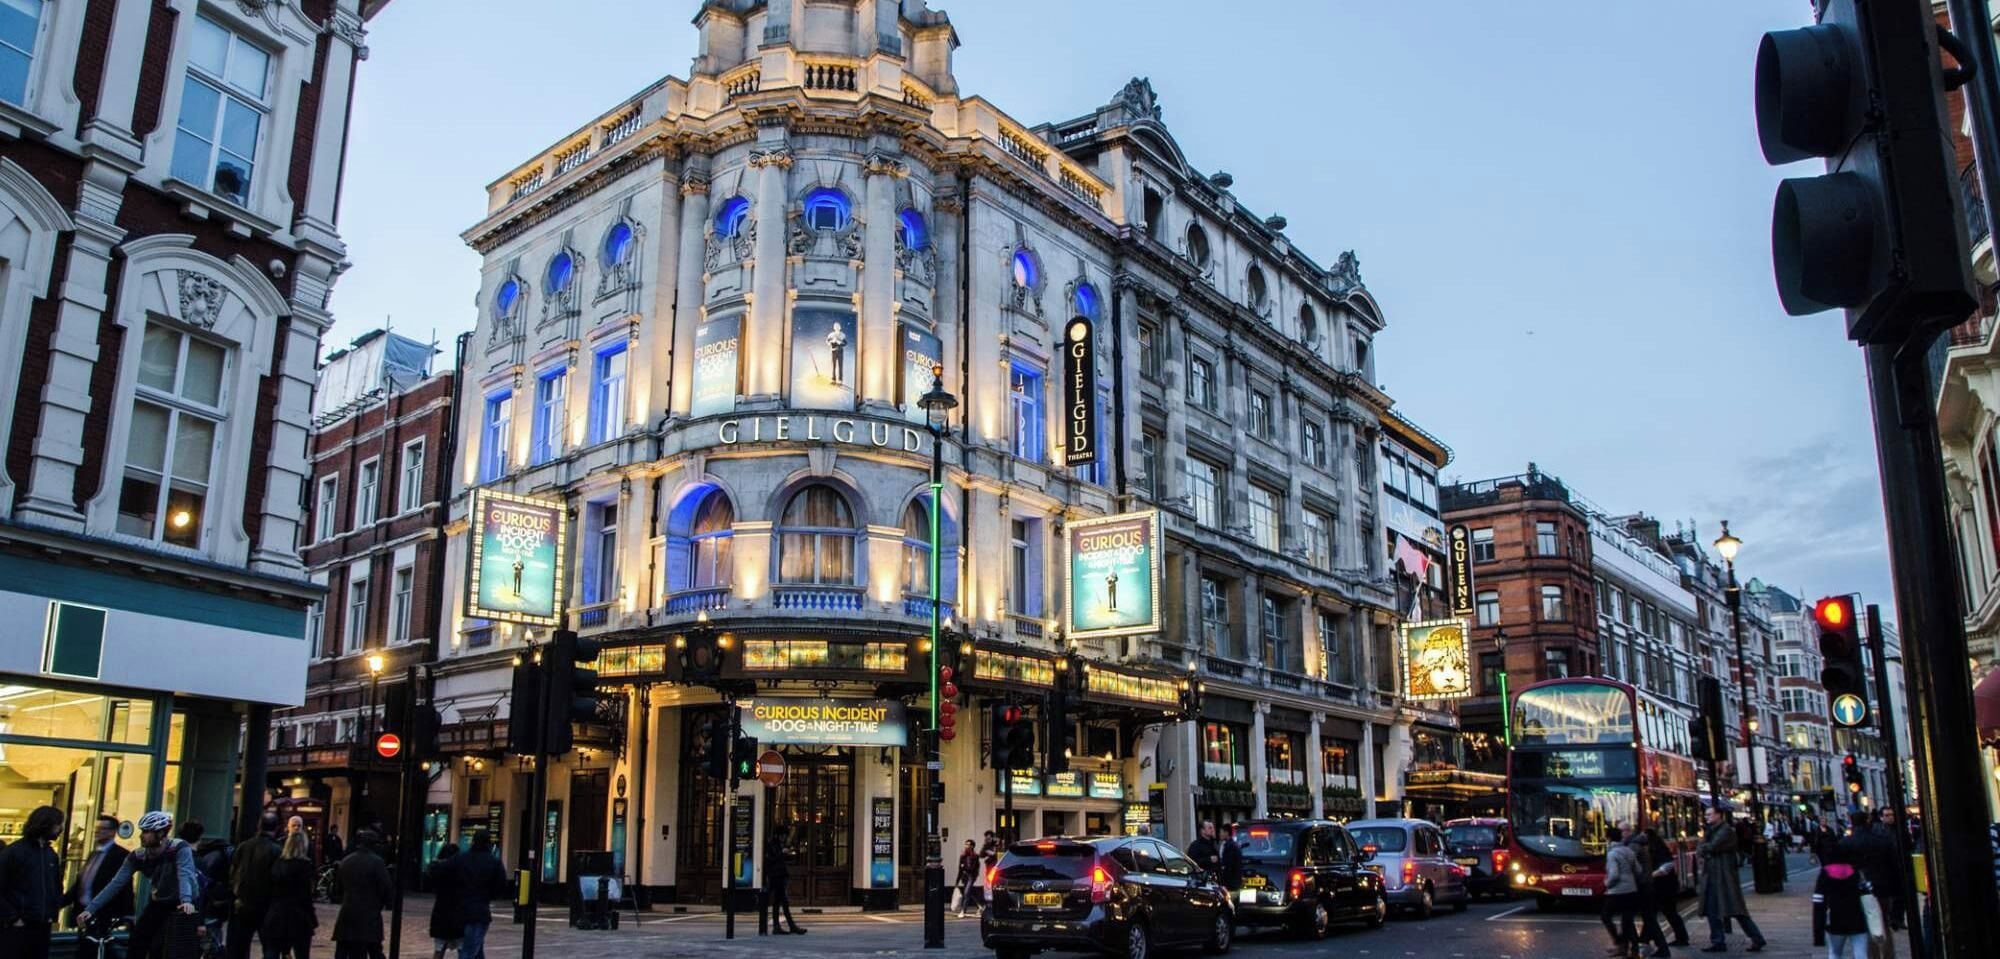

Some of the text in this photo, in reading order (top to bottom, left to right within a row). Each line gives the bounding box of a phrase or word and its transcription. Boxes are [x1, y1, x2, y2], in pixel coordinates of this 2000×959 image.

[695, 338, 737, 359] CURIOUS
[1072, 342, 1087, 452] GIELGUD
[719, 416, 921, 452] GIELGUD
[1067, 451, 1093, 462] THEATRE
[491, 510, 551, 531] CURIOUS
[500, 525, 545, 541] INCIDENT
[502, 534, 535, 550] DOG
[1080, 531, 1142, 552] CURIOUS
[1119, 544, 1144, 557] DOG
[1454, 541, 1468, 608] QUEENS
[754, 705, 887, 721] CURIOUS INCIDENT
[772, 719, 806, 732] DOG
[813, 721, 879, 733] NIGHT-TIME
[1583, 751, 1598, 763] 14
[1576, 765, 1602, 775] Heath
